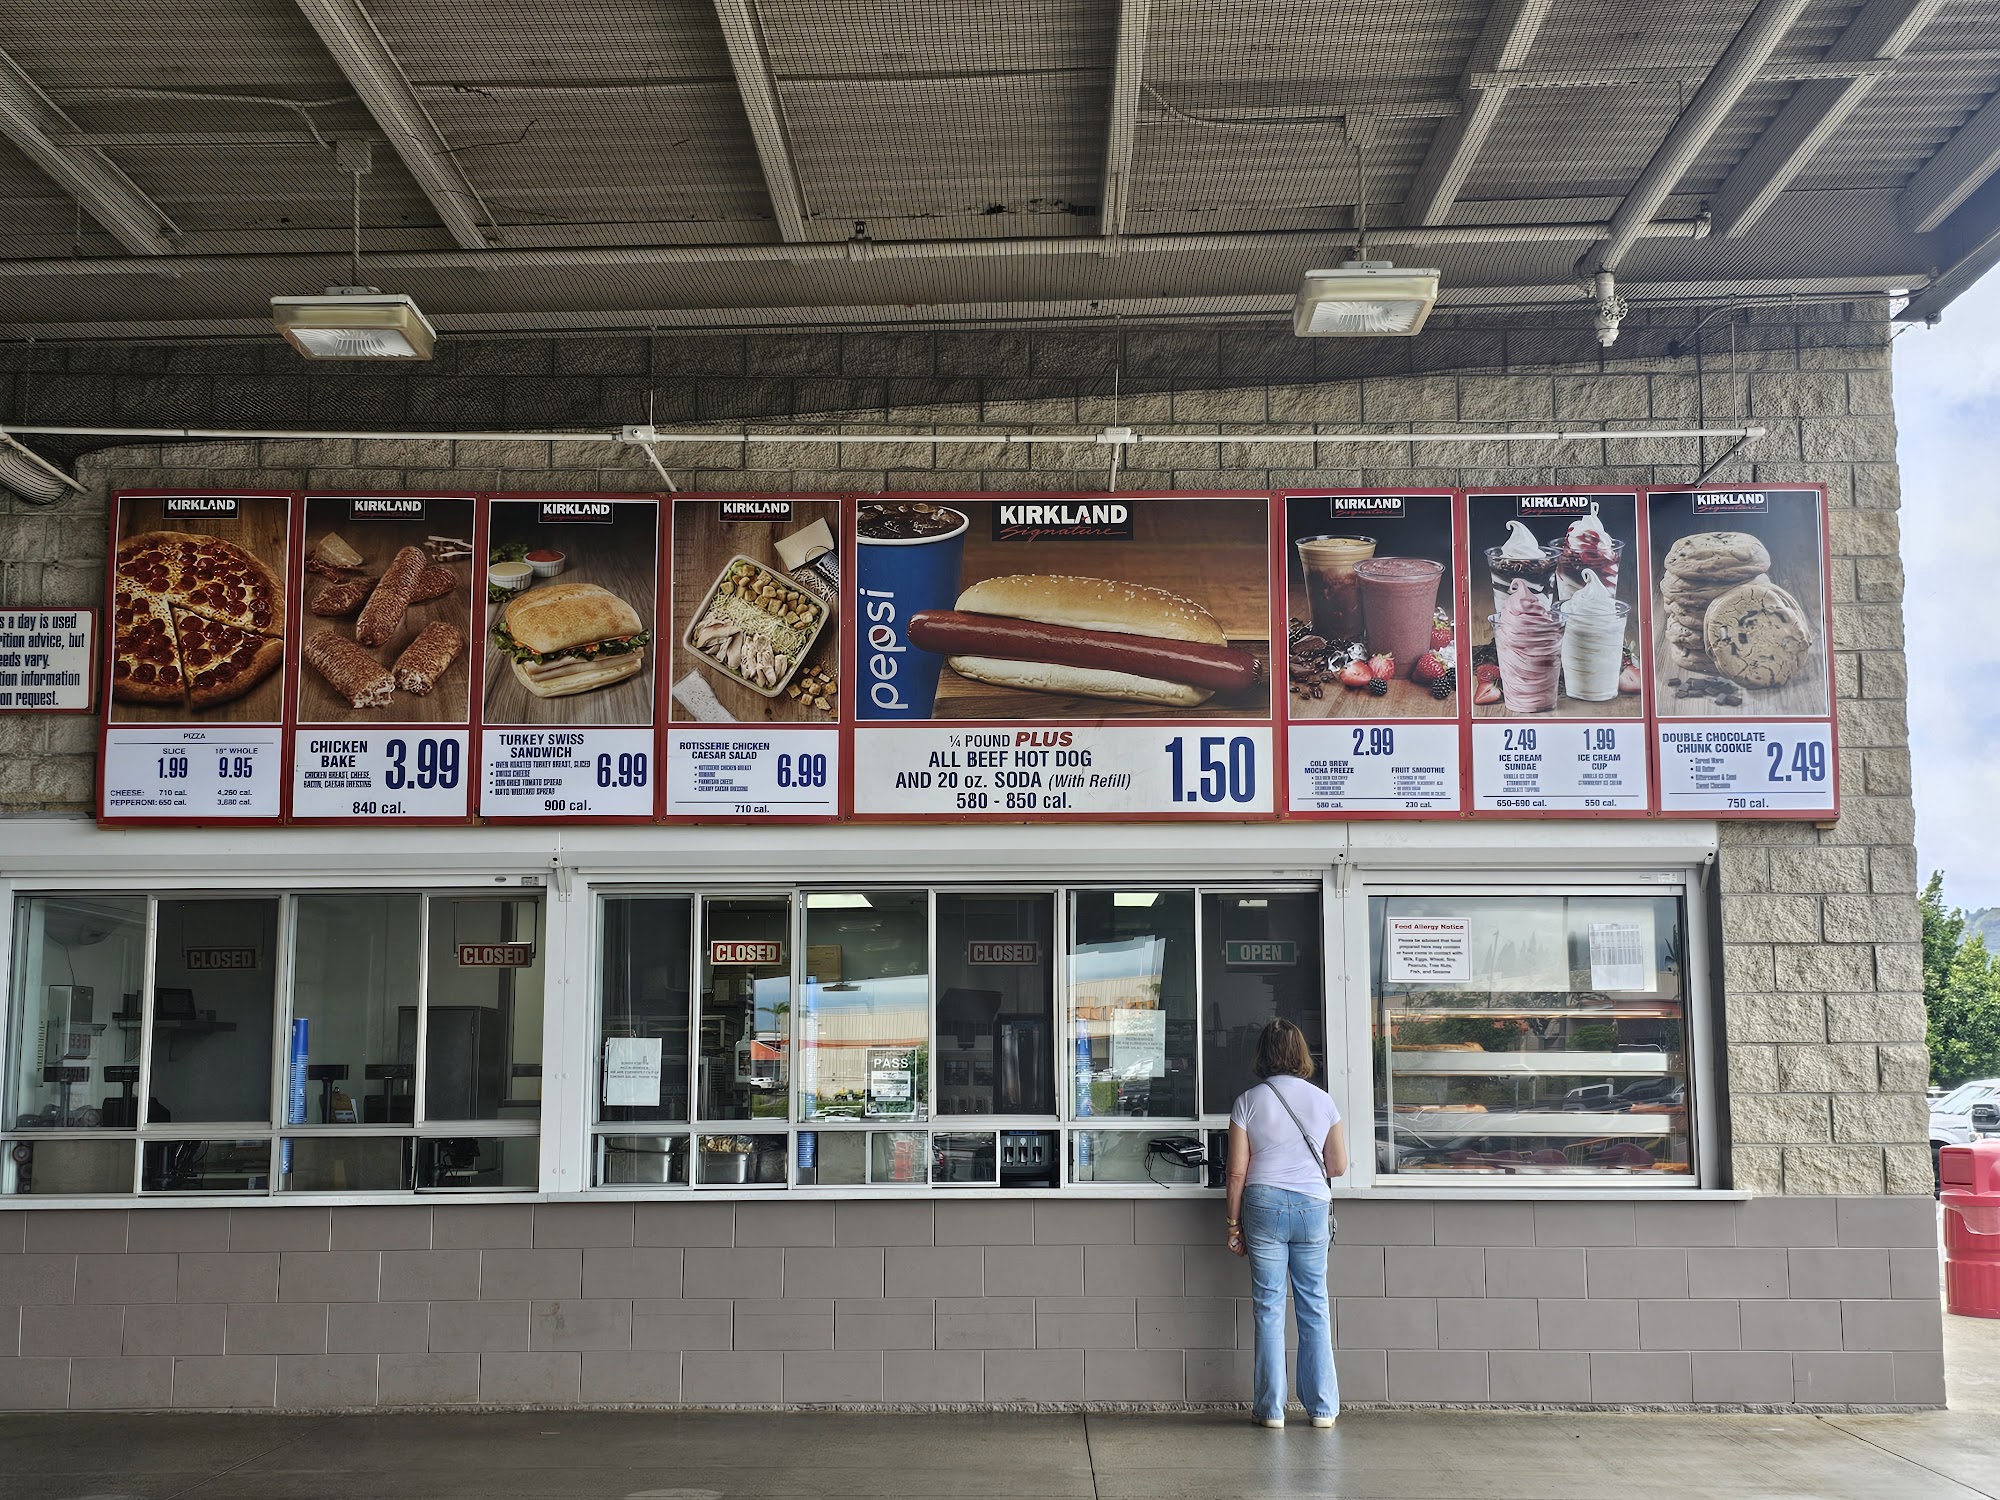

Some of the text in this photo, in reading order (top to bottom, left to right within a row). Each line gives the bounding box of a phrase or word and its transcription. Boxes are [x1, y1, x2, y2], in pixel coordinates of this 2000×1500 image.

[168, 500, 235, 510] KIRKLAND
[355, 501, 421, 511] KIRKLAND
[1335, 499, 1401, 509] KIRKLAND
[1522, 497, 1588, 507] KIRKLAND
[1698, 494, 1764, 505] KIRKLAND
[543, 504, 610, 514] KIRKLAND
[724, 503, 789, 513] KIRKLAND
[1001, 505, 1127, 524] KIRKLAND
[1000, 525, 1127, 542] Signature
[9, 616, 14, 628] a
[18, 614, 36, 631] day
[40, 614, 48, 628] is
[53, 613, 76, 628] used
[29, 633, 64, 649] advice,
[69, 633, 84, 647] but
[859, 588, 908, 709] pepsi
[25, 654, 50, 669] vary.
[21, 670, 79, 686] information
[16, 691, 58, 708] request.
[499, 734, 584, 745] TURKEY SWISS
[965, 734, 1010, 747] POUND
[1016, 732, 1073, 747] PLUS
[1353, 728, 1394, 755] 2.99
[1504, 729, 1537, 751] 2.49
[1583, 729, 1615, 750] 1.99
[1662, 733, 1765, 742] DOUBLE CHOCOLATE
[310, 740, 367, 753] CHICKEN
[511, 747, 571, 758] SANDWICH
[680, 742, 729, 750] ROTISSERIE
[1677, 744, 1752, 753] CHUNK COOKIE
[321, 755, 356, 768] BAKE
[386, 739, 459, 789] 3.99
[929, 751, 1092, 767] ALL BEEF HOT DOG
[1767, 742, 1825, 782] 2.49
[158, 757, 188, 778] 1.99
[219, 757, 253, 778] 9.95
[597, 753, 647, 787] 6.99
[777, 754, 826, 787] 6.99
[1165, 736, 1256, 802] 1.50
[896, 772, 1131, 790] AND 20 oz. SODA (With Refill)
[353, 802, 406, 814] 840 cal.
[544, 800, 591, 811] 900 cal.
[956, 793, 987, 809] 580
[1006, 793, 1036, 809] 850
[1043, 793, 1072, 809] cal.
[1728, 799, 1769, 808] 750 cal.
[735, 805, 769, 813] 710 cal.
[464, 948, 524, 964] CLOSED
[716, 945, 777, 961] CLOSED
[974, 945, 1033, 961] CLOSED
[1241, 945, 1282, 960] OPEN
[190, 953, 253, 968] CLOSED
[874, 1058, 908, 1068] PASS
